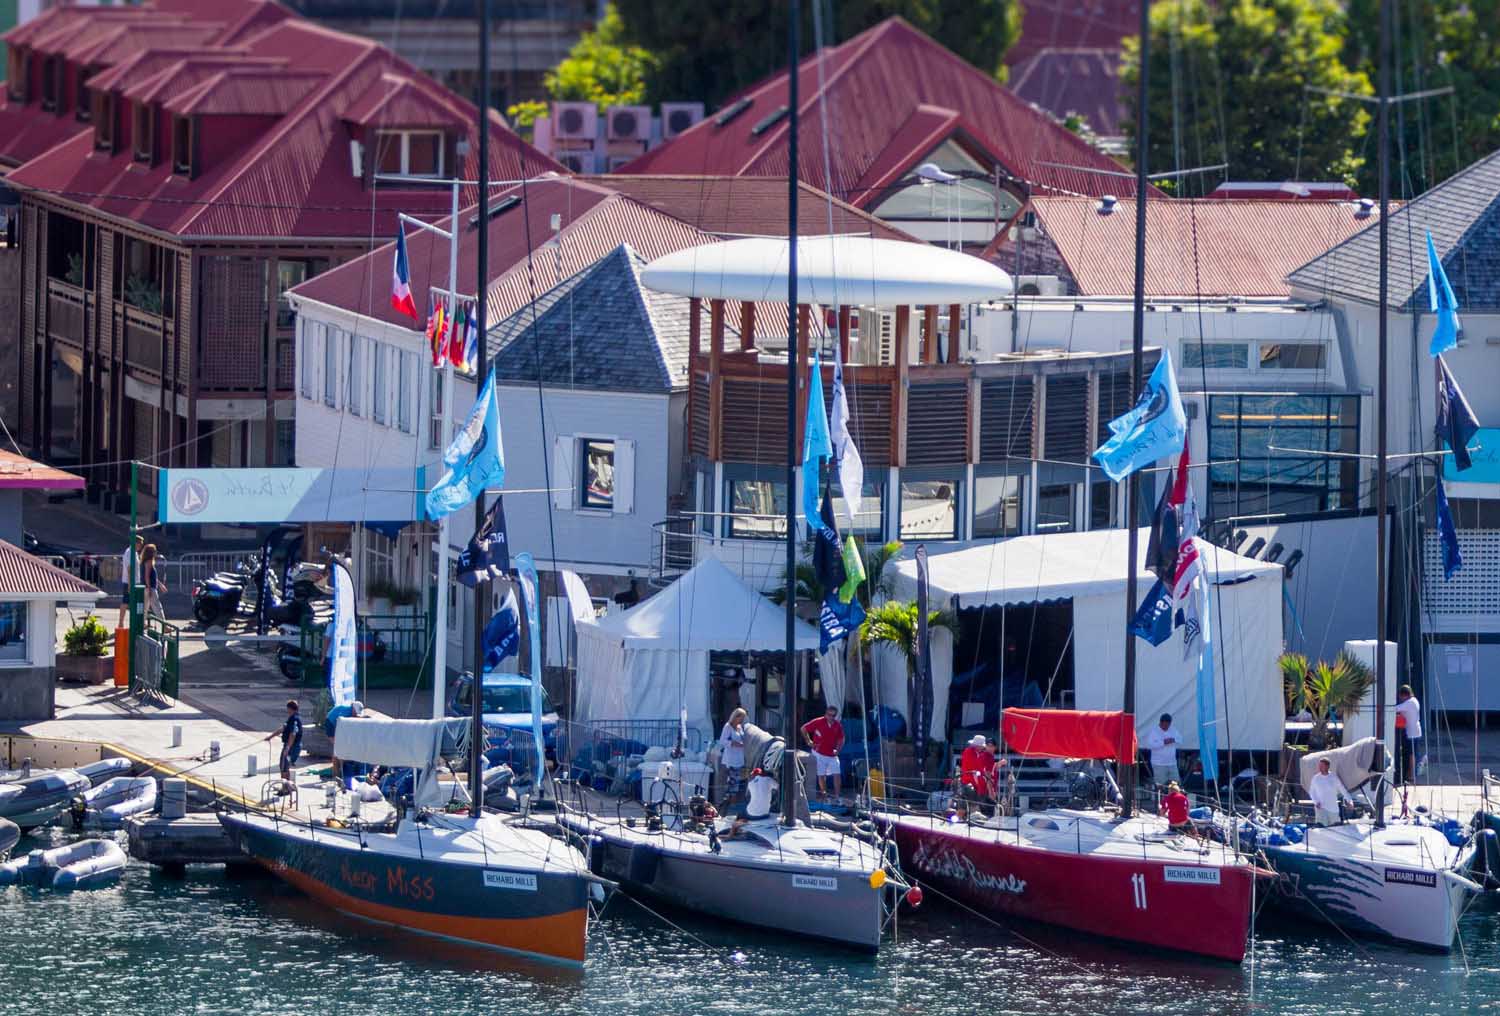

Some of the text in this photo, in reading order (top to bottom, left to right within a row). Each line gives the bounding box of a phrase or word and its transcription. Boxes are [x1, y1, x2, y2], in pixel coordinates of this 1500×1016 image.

[386, 863, 436, 902] Miss
[1167, 869, 1217, 881] RICHARD MILLE
[1387, 870, 1435, 884] RICHARD MILLE
[1131, 872, 1148, 910] 11
